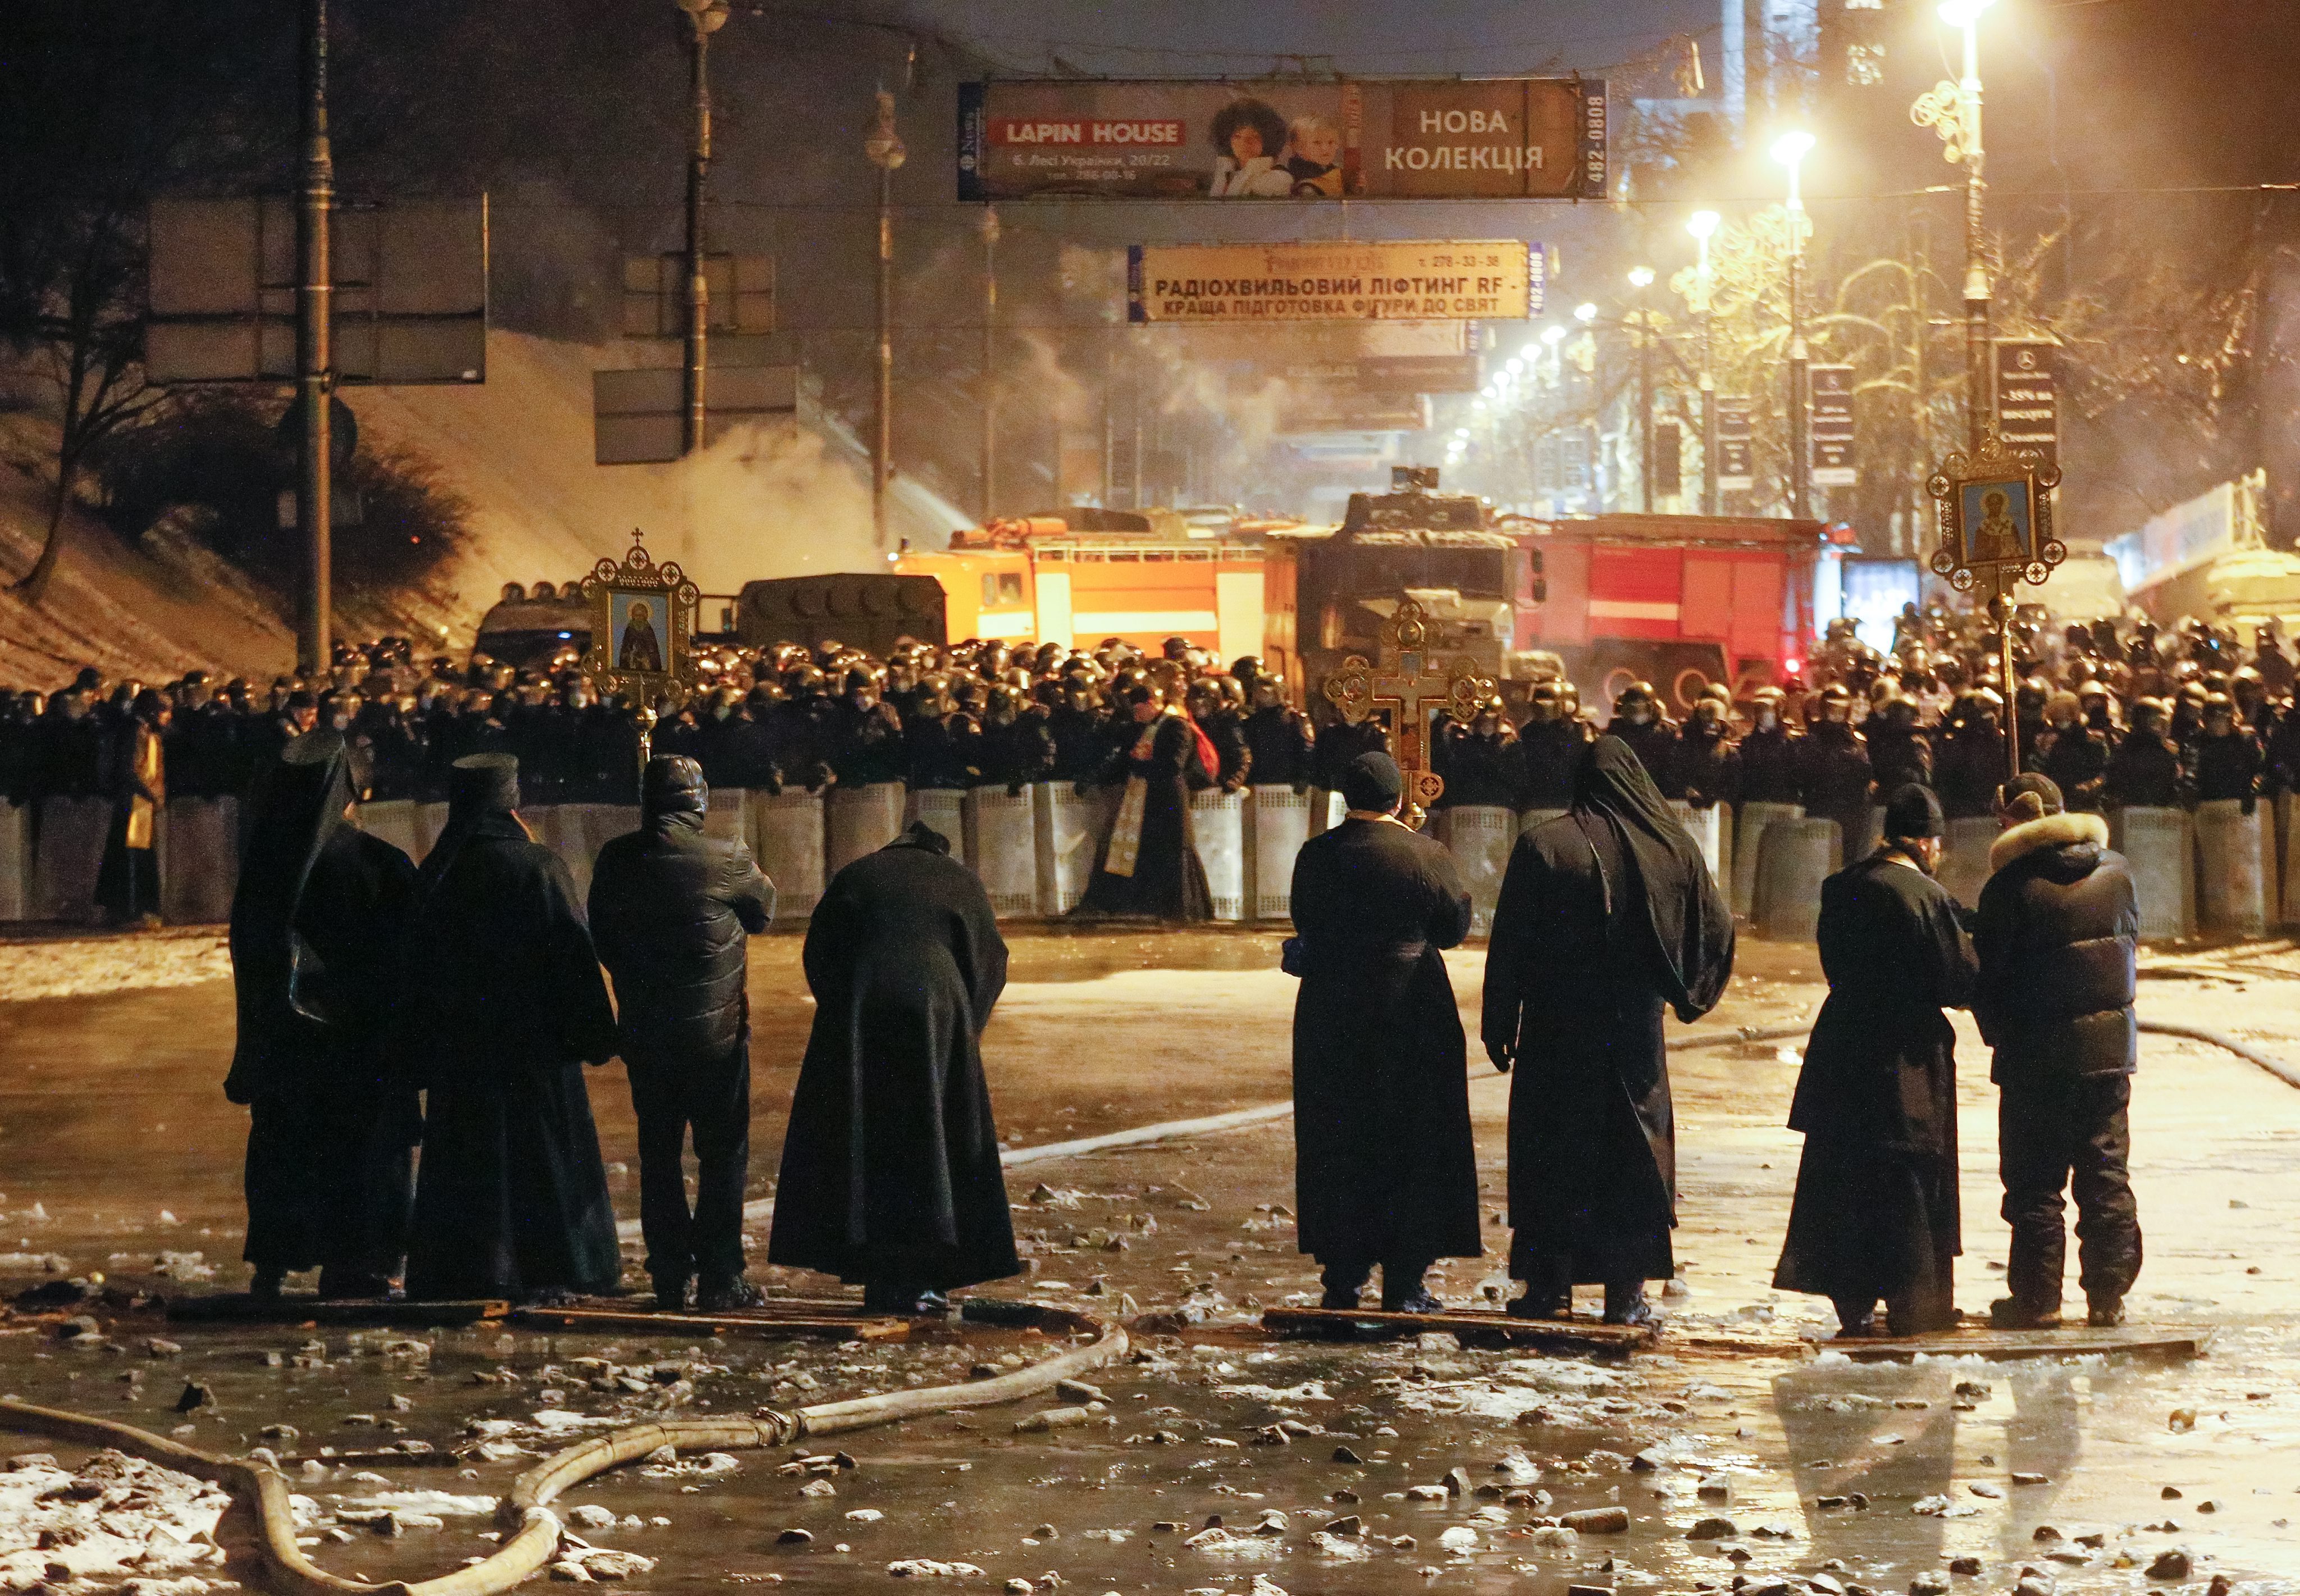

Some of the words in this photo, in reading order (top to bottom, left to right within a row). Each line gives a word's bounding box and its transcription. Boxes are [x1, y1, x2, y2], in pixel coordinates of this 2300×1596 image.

[1007, 123, 1080, 143] LAPIN
[1093, 123, 1178, 143] HOUSE
[1420, 111, 1509, 134] НОВА
[1587, 95, 1605, 184] 482-0808
[1385, 146, 1543, 175] КОЛЕКЦІЯ
[1155, 275, 1362, 298] РАДІОХВИЛЬОВИЙ
[1370, 277, 1470, 295] ЛІФТИНГ
[1477, 277, 1504, 295] RF
[1234, 299, 1346, 316] ПІДГОТОВКА
[1422, 298, 1446, 313] ДО
[1454, 298, 1500, 313] СВЯТ
